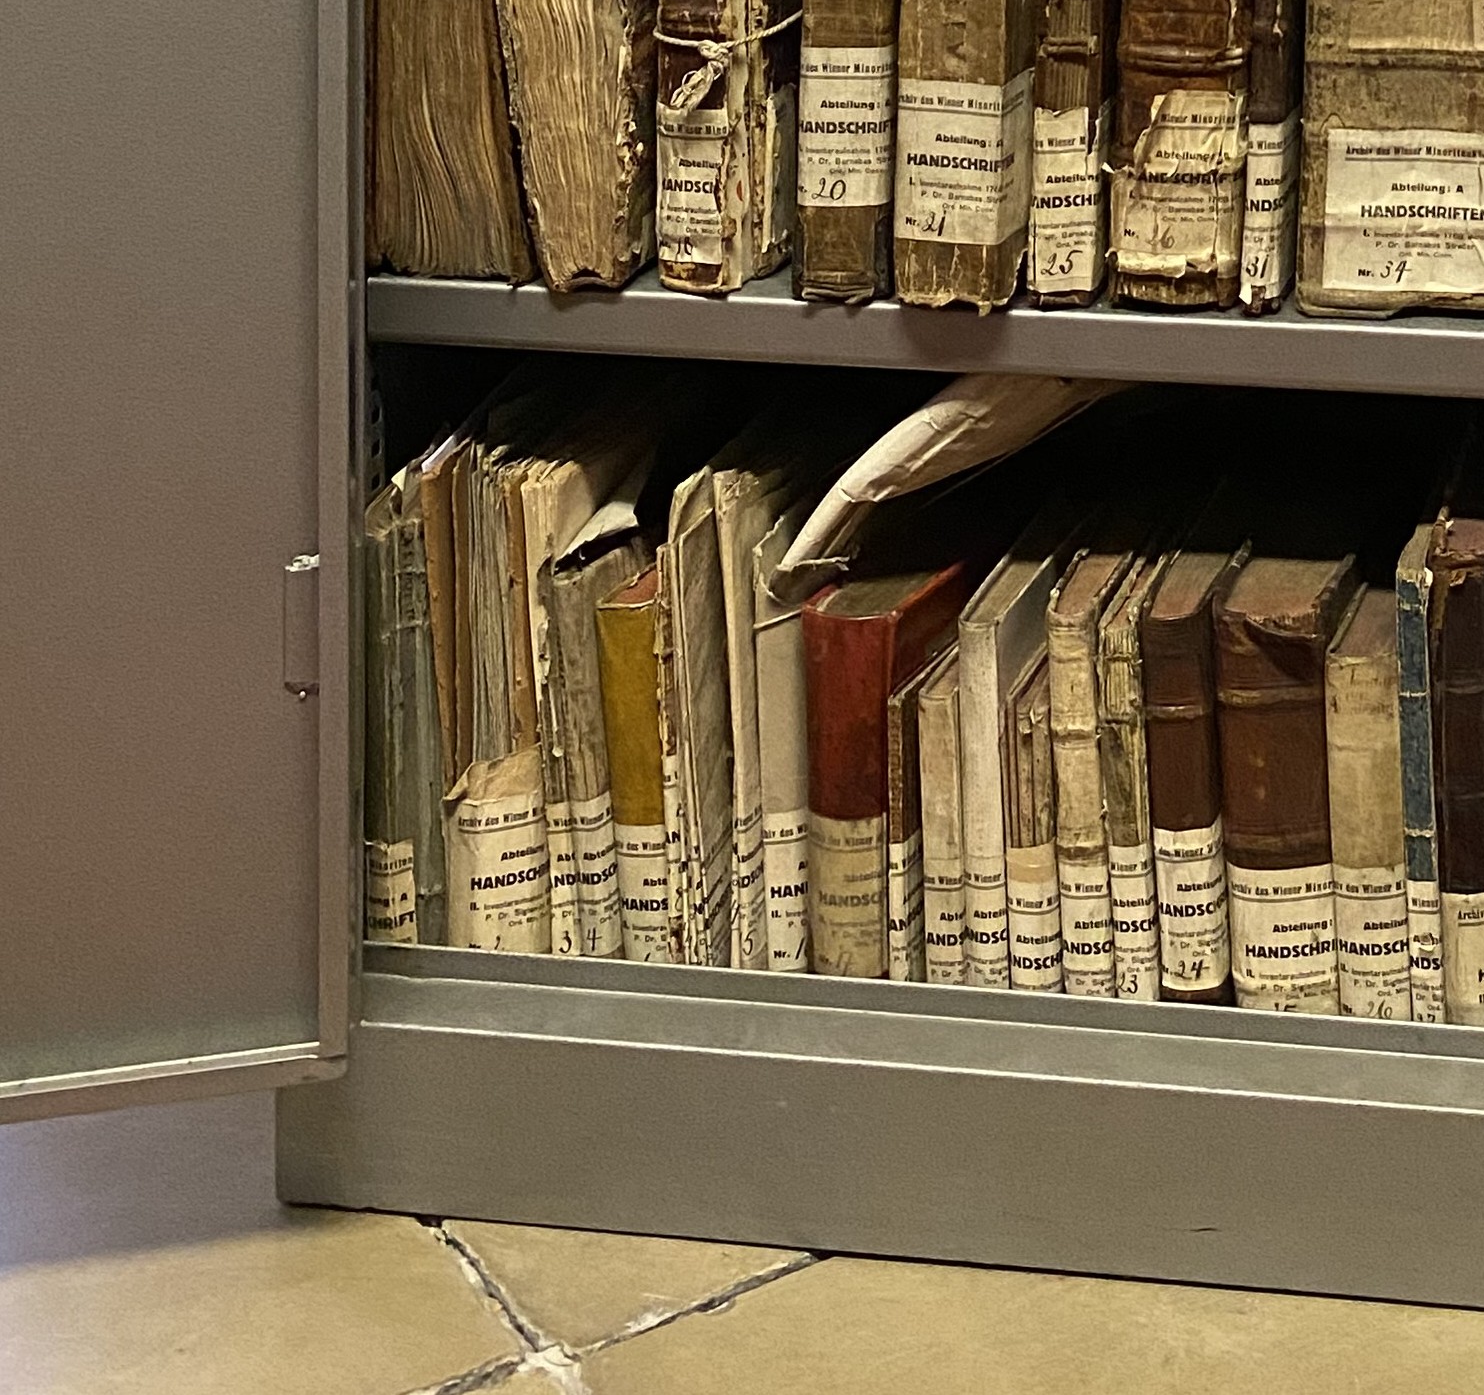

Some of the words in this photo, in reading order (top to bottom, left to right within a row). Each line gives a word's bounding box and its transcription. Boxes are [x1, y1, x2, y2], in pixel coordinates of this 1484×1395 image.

[822, 63, 850, 73] Wiener
[821, 100, 880, 110] Abteilung:
[937, 97, 964, 108] Wiener
[935, 134, 991, 148] Abteilung:
[1048, 138, 1071, 147] Wiener
[1346, 145, 1372, 156] Archiv
[1394, 146, 1422, 156] Wiener
[812, 178, 846, 200] 20
[1391, 183, 1451, 195] Abteilung:
[1456, 185, 1464, 193] A
[906, 217, 919, 226] Nr.
[1124, 229, 1139, 239] Nr.
[1041, 251, 1082, 275] 25
[1358, 269, 1374, 277] Nr.
[458, 817, 481, 827] Archiv
[503, 811, 529, 823] Wiener
[1174, 846, 1204, 857] Wiener
[1111, 862, 1138, 872] Wiener
[974, 873, 1001, 882] Wiener
[1075, 882, 1103, 892] Wiener
[1273, 884, 1302, 895] Wiener
[1362, 884, 1392, 894] Wiener
[1016, 898, 1044, 908] Wiener
[1457, 909, 1484, 920] Archiv
[1272, 920, 1333, 933] Abteilung:
[559, 930, 572, 953] 3
[586, 927, 602, 951] 4
[1177, 959, 1210, 980] 24
[1117, 973, 1138, 994] 23
